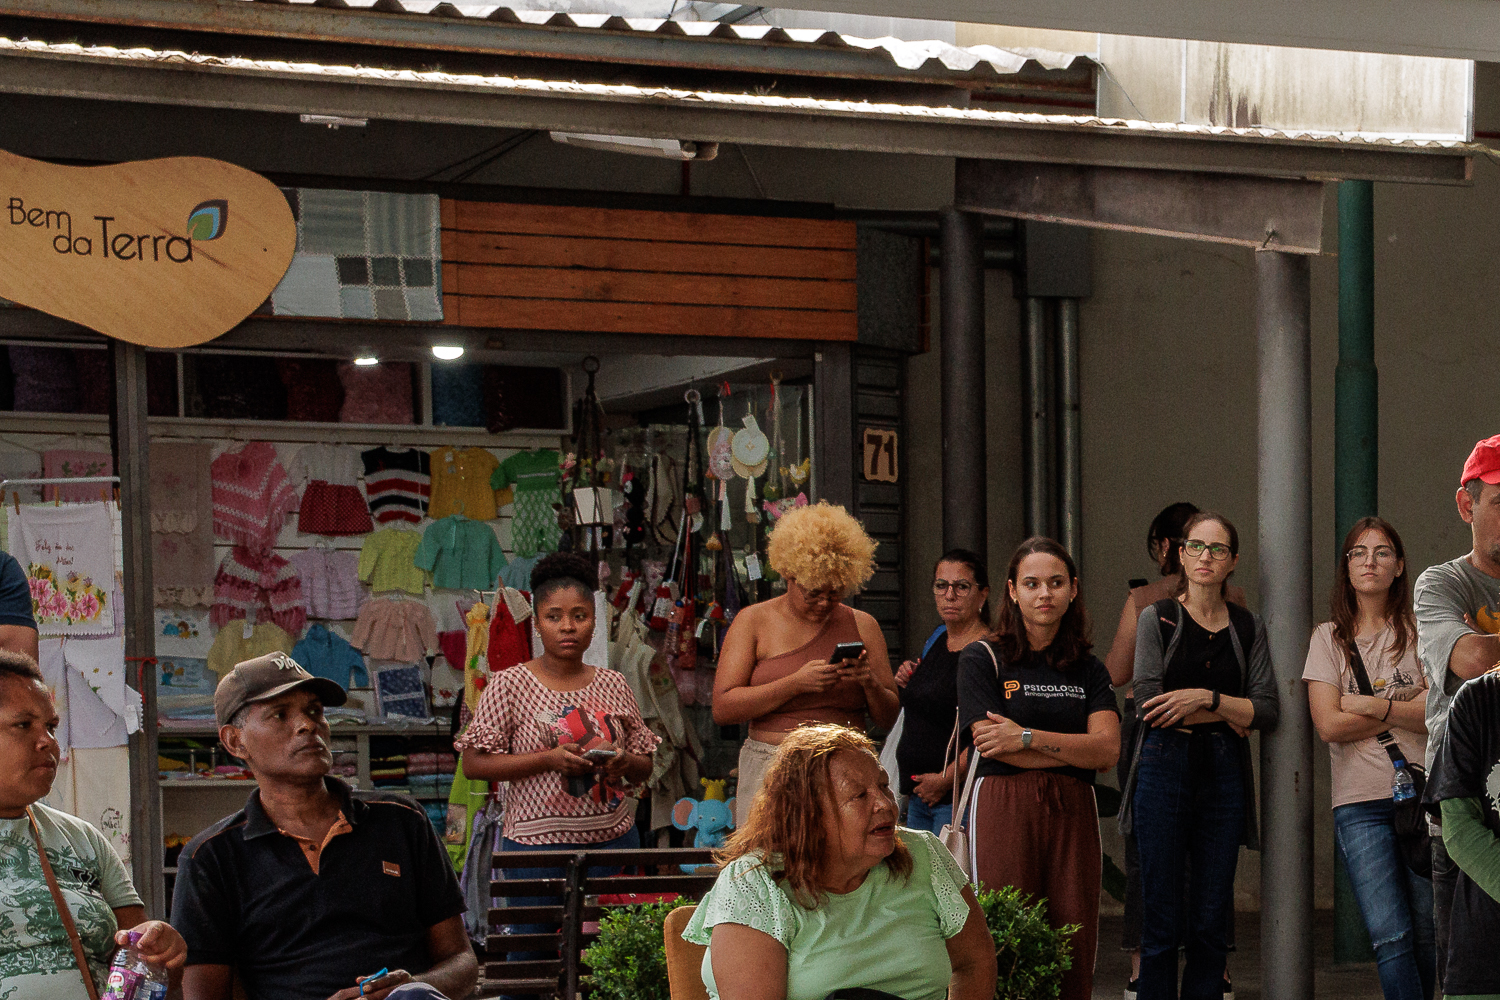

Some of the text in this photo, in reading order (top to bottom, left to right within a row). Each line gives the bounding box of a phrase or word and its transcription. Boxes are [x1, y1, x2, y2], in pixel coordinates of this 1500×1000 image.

[7, 197, 71, 229] Bem
[53, 214, 194, 263] da Terra
[867, 434, 895, 476] 71
[1023, 684, 1085, 693] PSICOLOGIA
